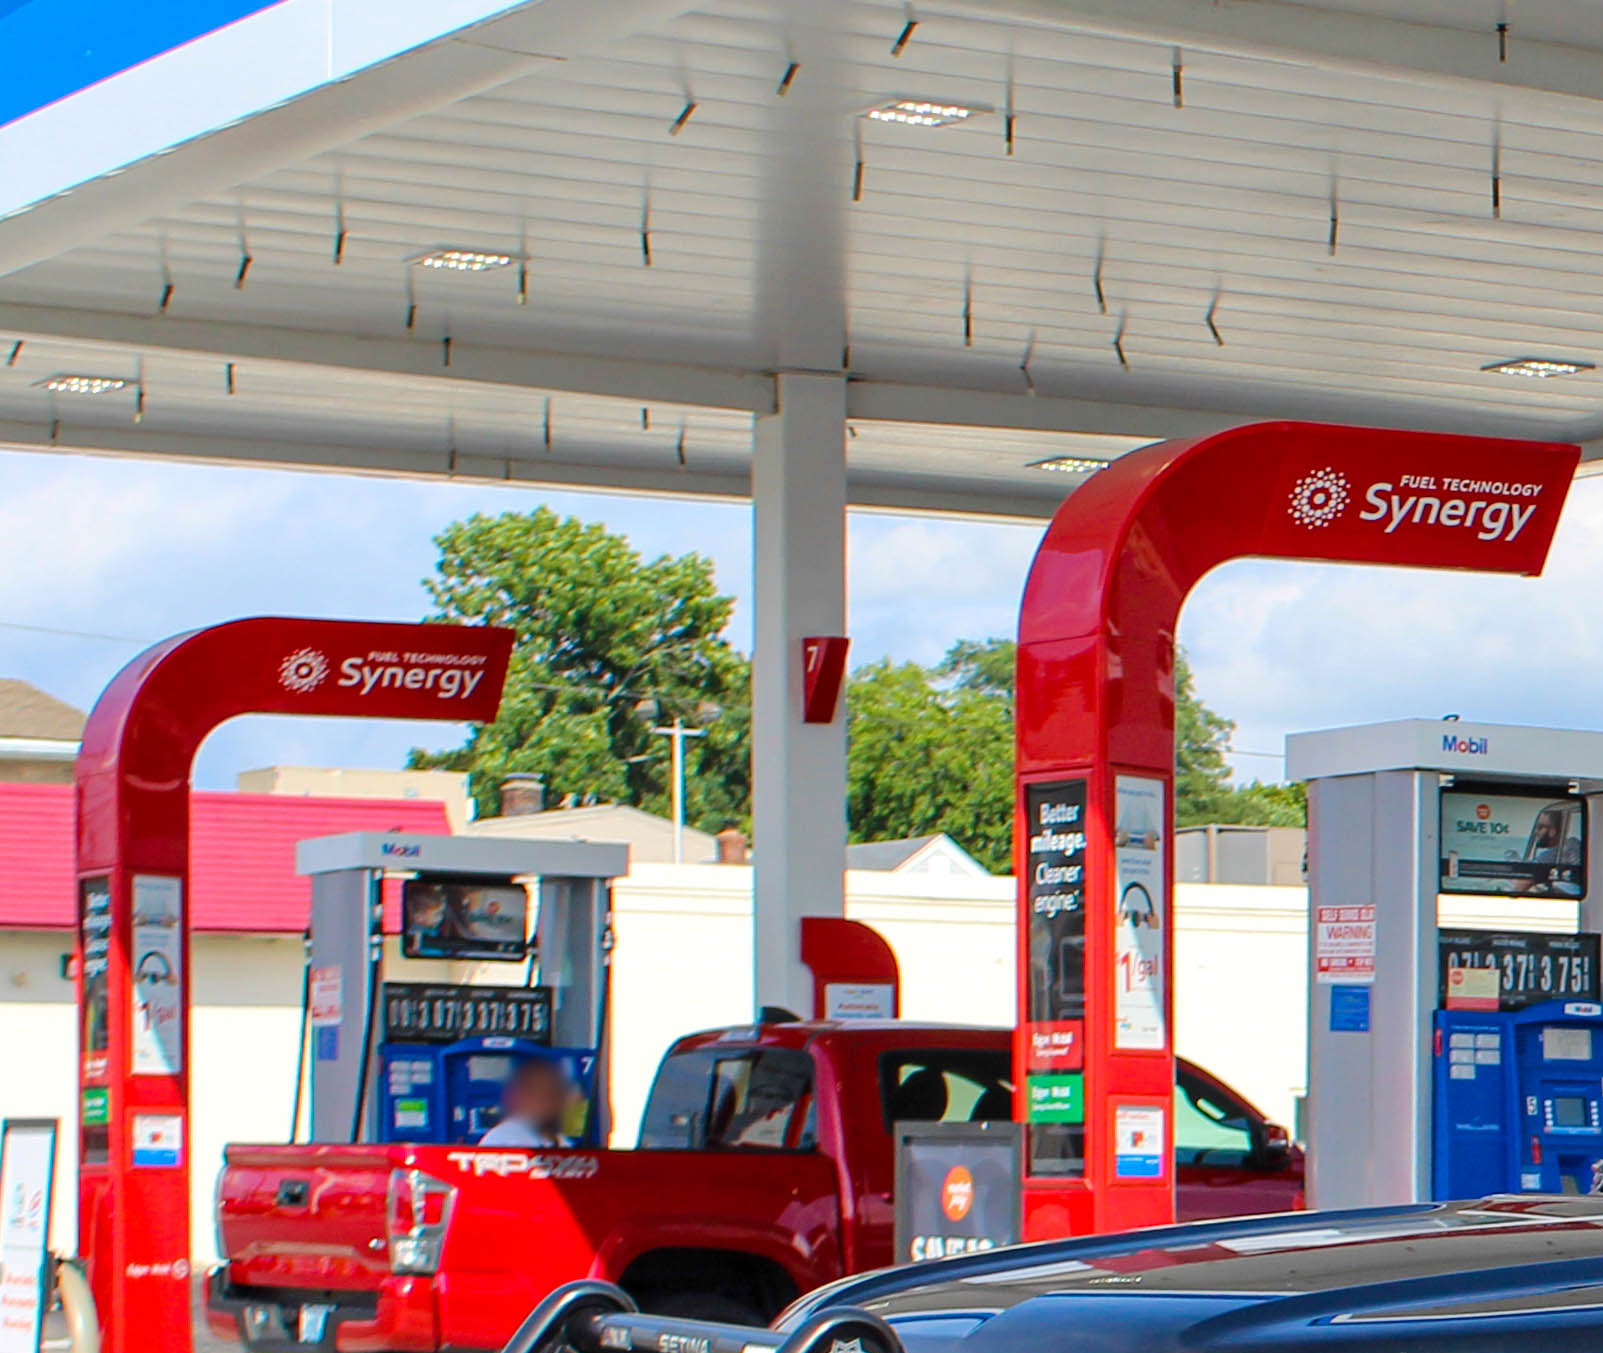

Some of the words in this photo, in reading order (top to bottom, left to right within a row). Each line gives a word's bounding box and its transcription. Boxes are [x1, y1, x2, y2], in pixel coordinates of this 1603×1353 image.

[1400, 475, 1437, 490] FUEL
[1442, 477, 1543, 497] TECHNOLOGY
[1359, 482, 1537, 541] Synergy
[367, 651, 400, 663] FUEL
[402, 652, 487, 666] TECHNOLOGY
[806, 646, 817, 672] 7
[338, 657, 485, 699] Synergy
[1442, 735, 1488, 755] Mobil
[1039, 802, 1081, 825] Better
[1456, 820, 1487, 834] SAVE
[1030, 828, 1087, 857] mileage.
[1035, 863, 1083, 885] Cleaner
[582, 1057, 594, 1075] 7
